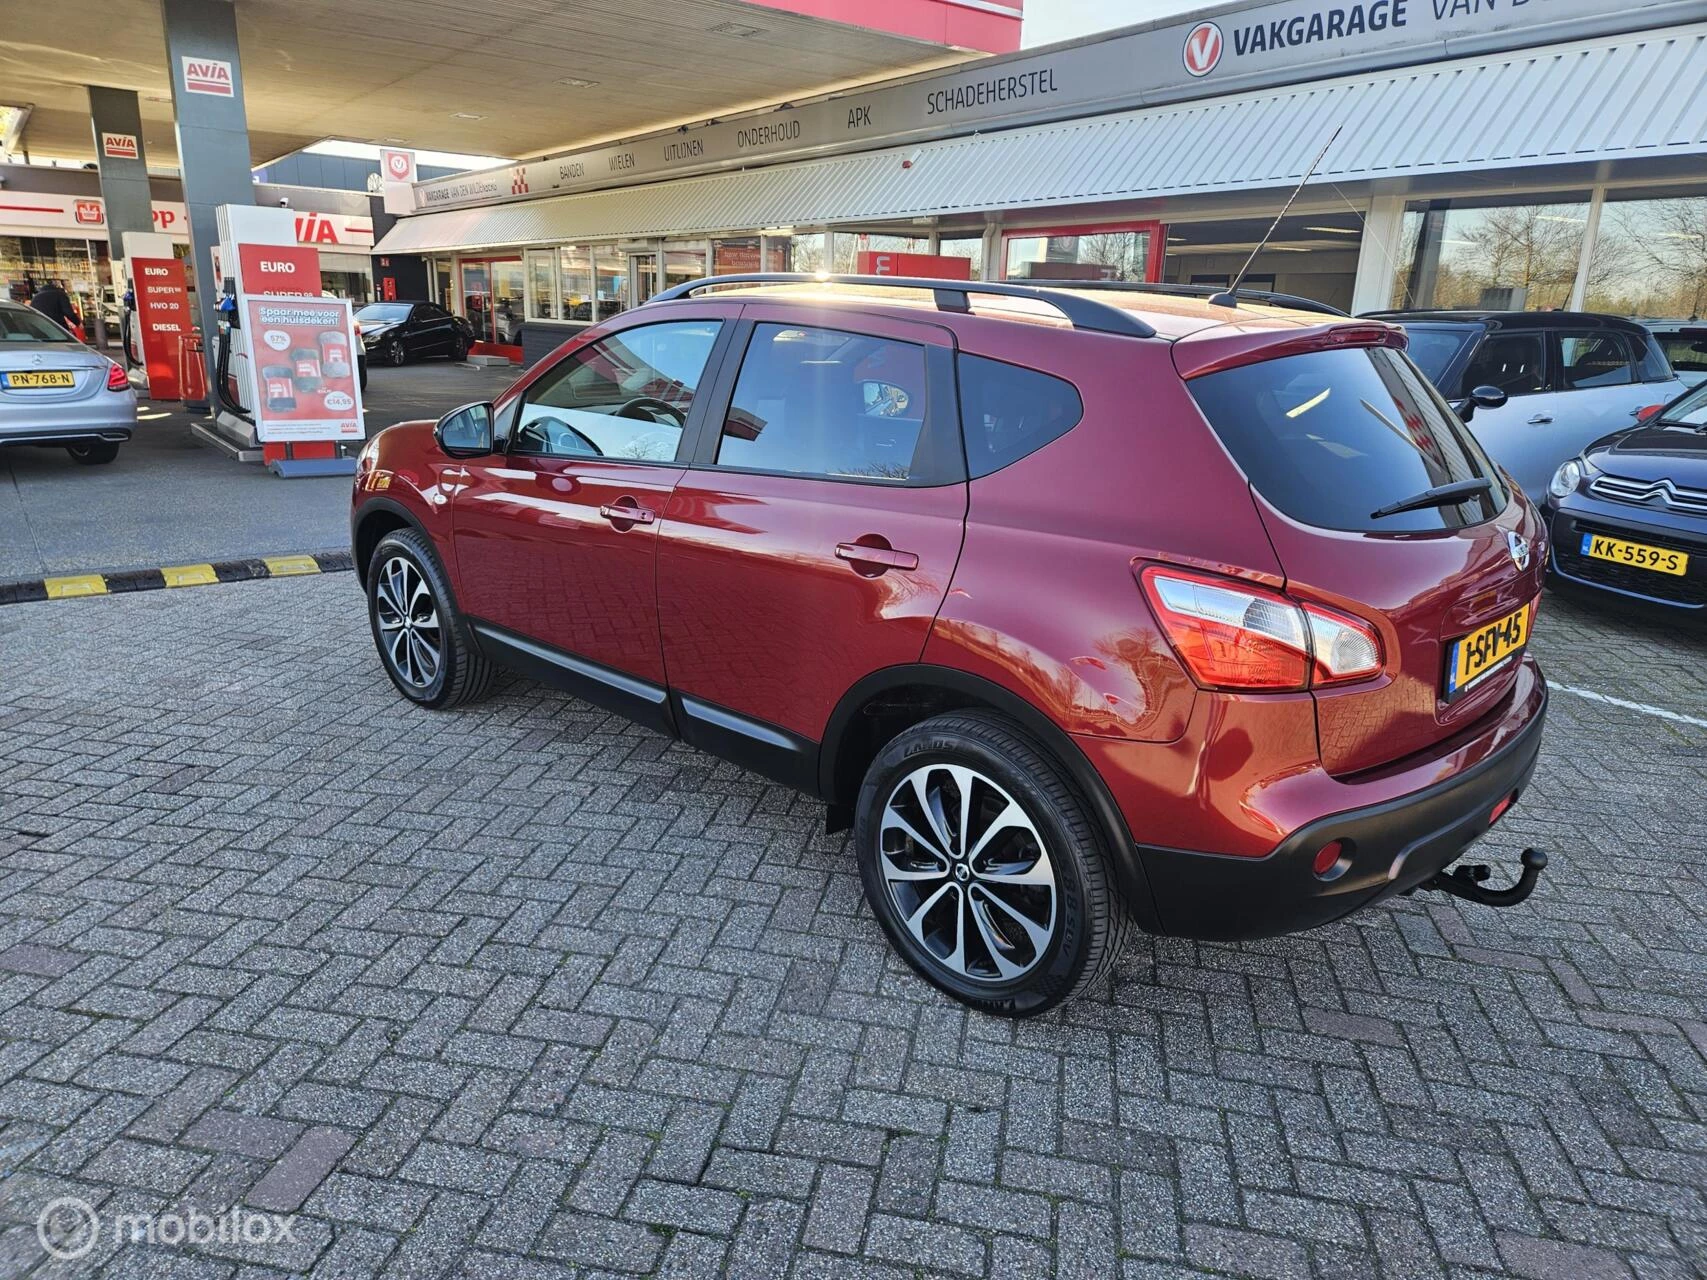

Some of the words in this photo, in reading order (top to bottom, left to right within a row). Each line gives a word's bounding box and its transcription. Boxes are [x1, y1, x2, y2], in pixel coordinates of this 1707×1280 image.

[1233, 0, 1408, 57] VAKGARAGE
[186, 62, 230, 81] AVIA
[559, 162, 585, 180] BANDEN
[608, 152, 636, 171] WIELEN
[663, 139, 704, 162] UITLIJNEN
[737, 120, 801, 149] ONDERHOUD
[847, 104, 872, 129] APK
[927, 68, 1058, 115] SCHADEHERSTEL
[105, 136, 136, 148] AVIA
[144, 267, 169, 276] EURO
[260, 260, 296, 273] EURO
[147, 286, 175, 294] SUPER
[150, 302, 168, 310] HVO
[260, 306, 292, 318] Spaar
[293, 309, 316, 317] mee
[261, 316, 281, 324] een
[282, 316, 338, 326] huisdeken!
[152, 323, 182, 332] DIESEL
[12, 374, 70, 385] PN-768-N
[1593, 538, 1679, 571] KK-559-S
